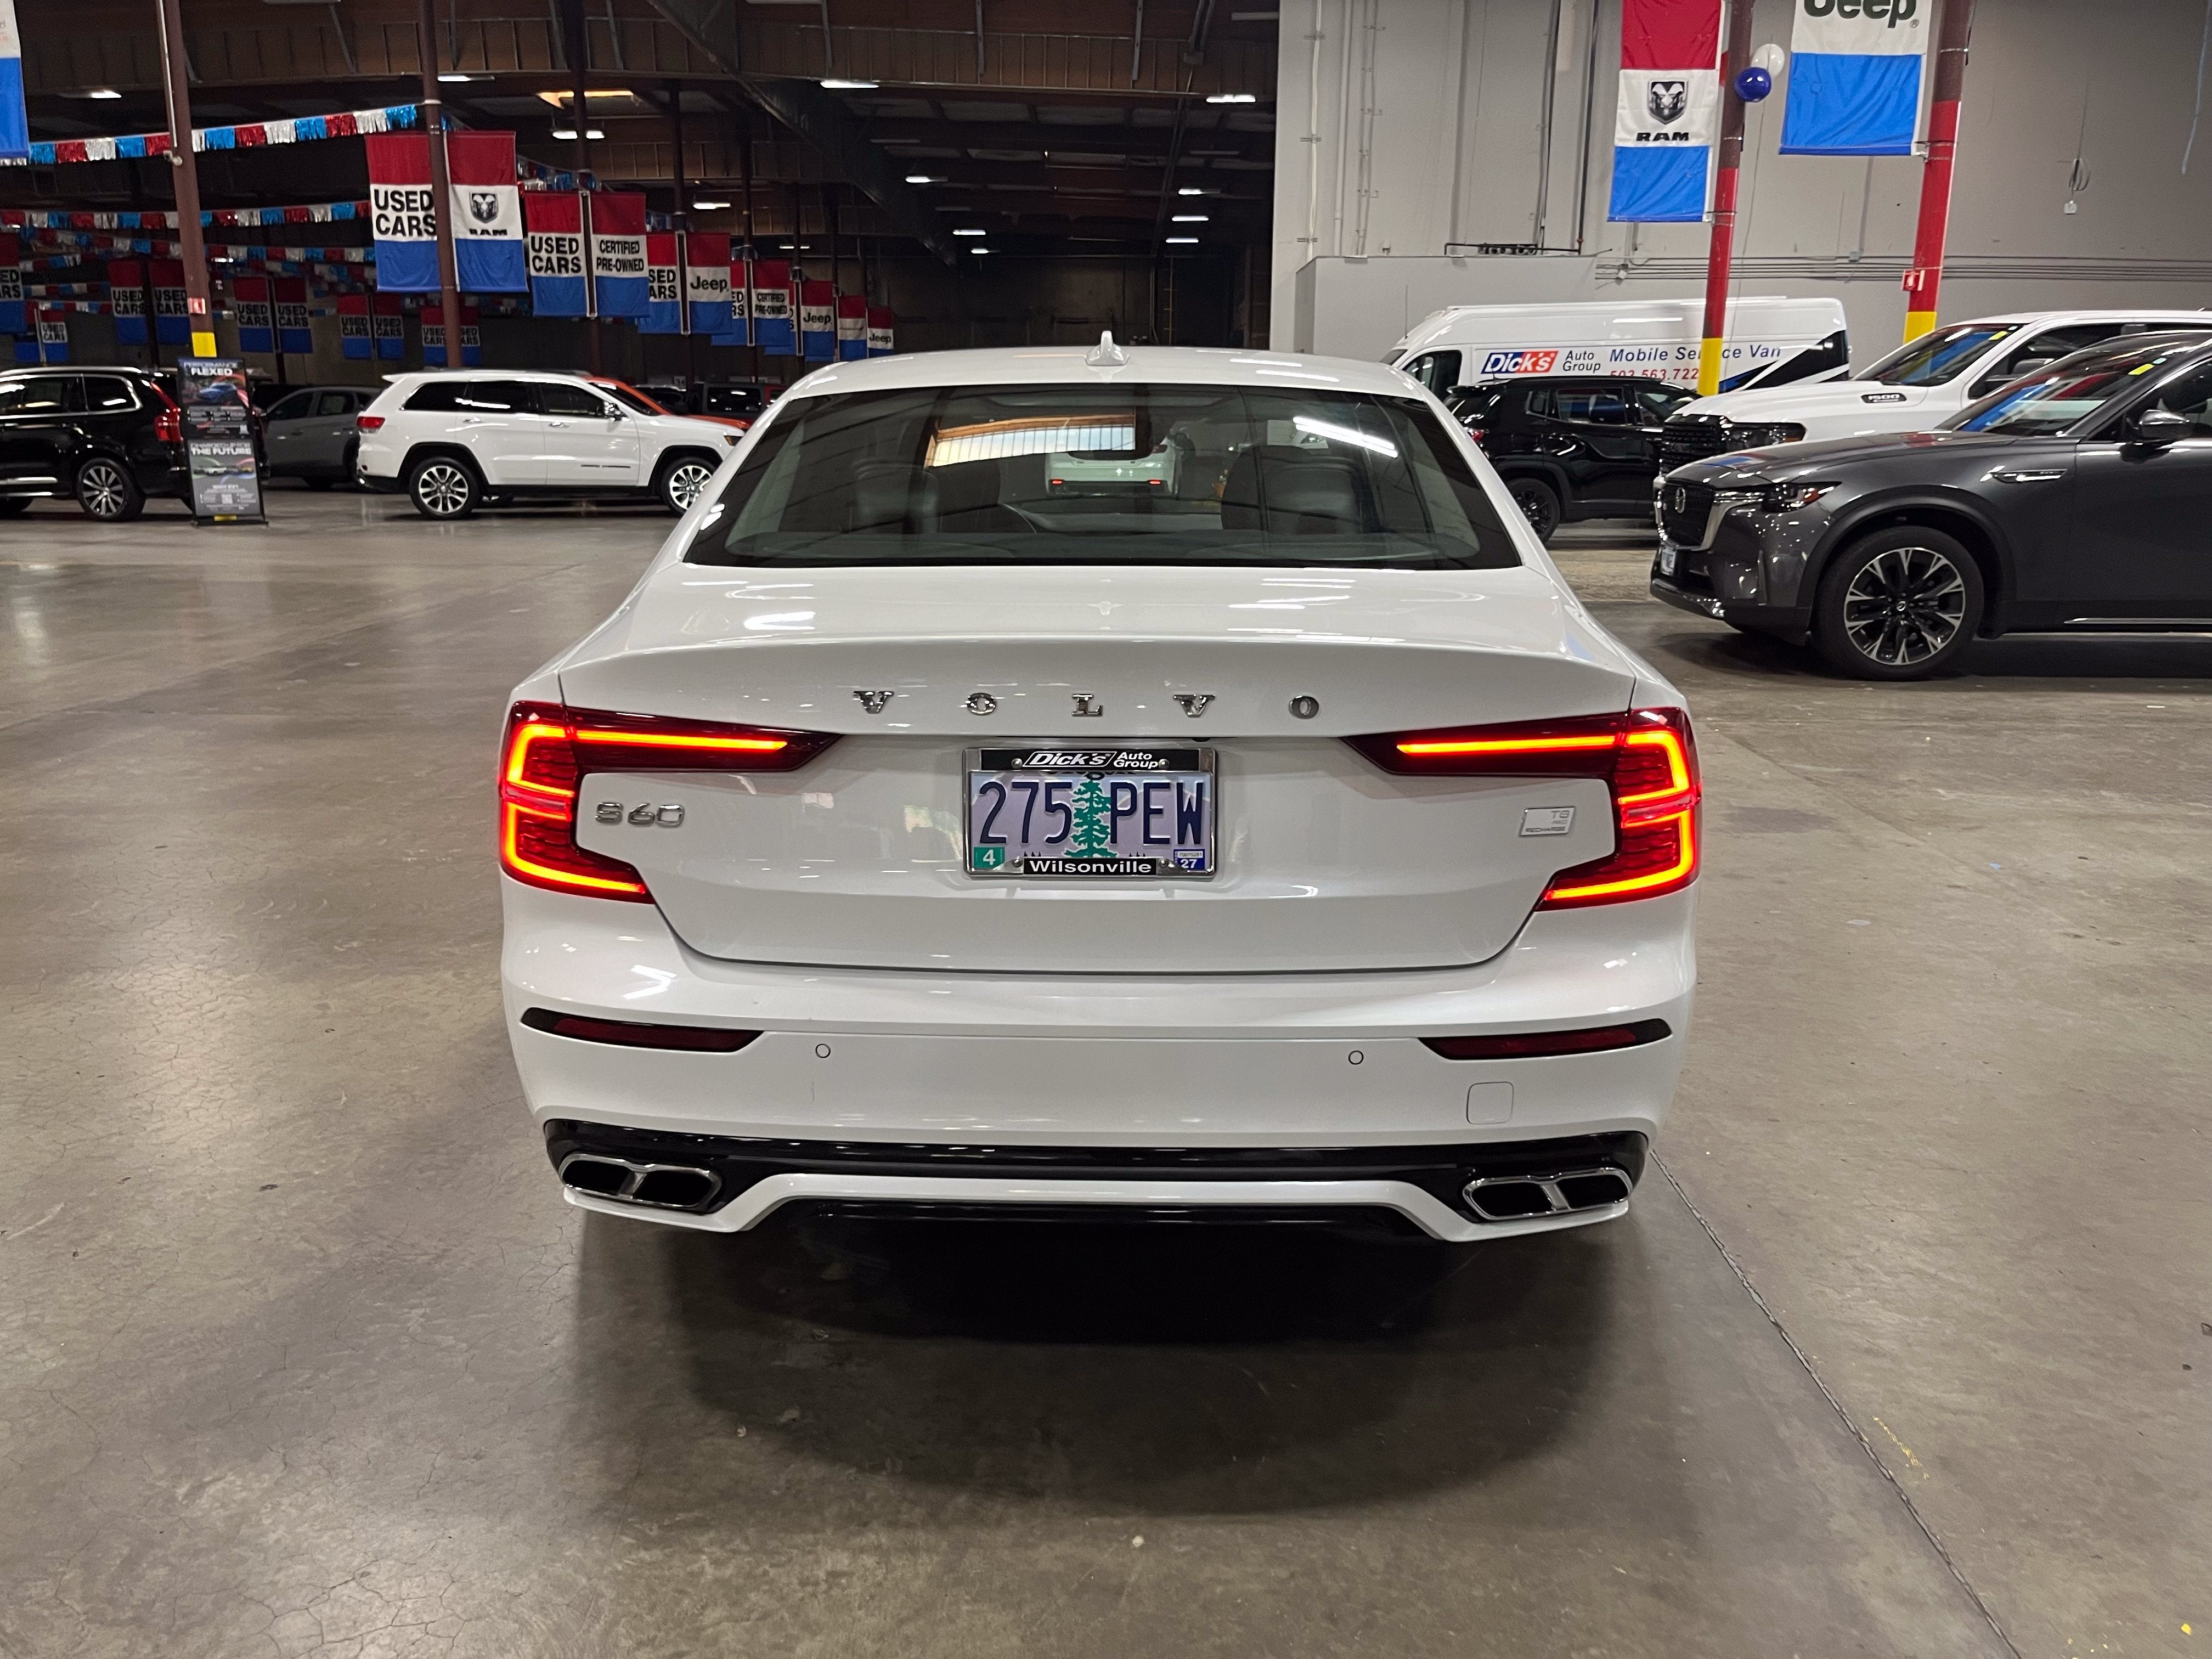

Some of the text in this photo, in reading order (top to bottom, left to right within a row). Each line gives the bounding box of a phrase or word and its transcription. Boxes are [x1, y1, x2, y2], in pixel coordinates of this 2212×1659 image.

[1636, 132, 1689, 141] RAM
[374, 189, 433, 212] USED
[376, 213, 436, 236] CARS
[531, 236, 579, 254] USED
[600, 240, 640, 255] CERTIFIED
[532, 256, 582, 273] CARS
[596, 257, 644, 272] PRE-OWNED
[0, 270, 19, 283] ED
[649, 269, 676, 283] SED
[690, 276, 727, 292] Jeep
[113, 290, 143, 301] USED
[650, 285, 677, 298] ARS
[757, 293, 785, 302] CERTIFIED
[115, 303, 147, 315] CARS
[238, 303, 267, 314] USED
[278, 305, 306, 315] USED
[755, 304, 787, 314] PRE-OWNED
[239, 315, 269, 326] CARS
[279, 317, 308, 327] CARS
[341, 317, 368, 325] USED
[376, 317, 401, 326] USED
[803, 312, 831, 325] Jeep
[869, 333, 891, 345] Jeep
[1565, 350, 1594, 361] Auto
[1610, 345, 1781, 362] Mobile Serce Van
[1485, 352, 1551, 373] Dick's
[1563, 361, 1601, 374] Group
[853, 690, 1320, 719] VOLVO
[1029, 753, 1106, 765] Dick's
[1116, 752, 1152, 760] Auto
[1113, 759, 1158, 769] Group
[595, 802, 685, 828] S60
[979, 781, 1204, 845] 275 PEW
[1551, 810, 1570, 819] T8
[983, 849, 996, 866] 4
[1180, 859, 1198, 868] 27
[1030, 860, 1152, 873] Wilsonville
